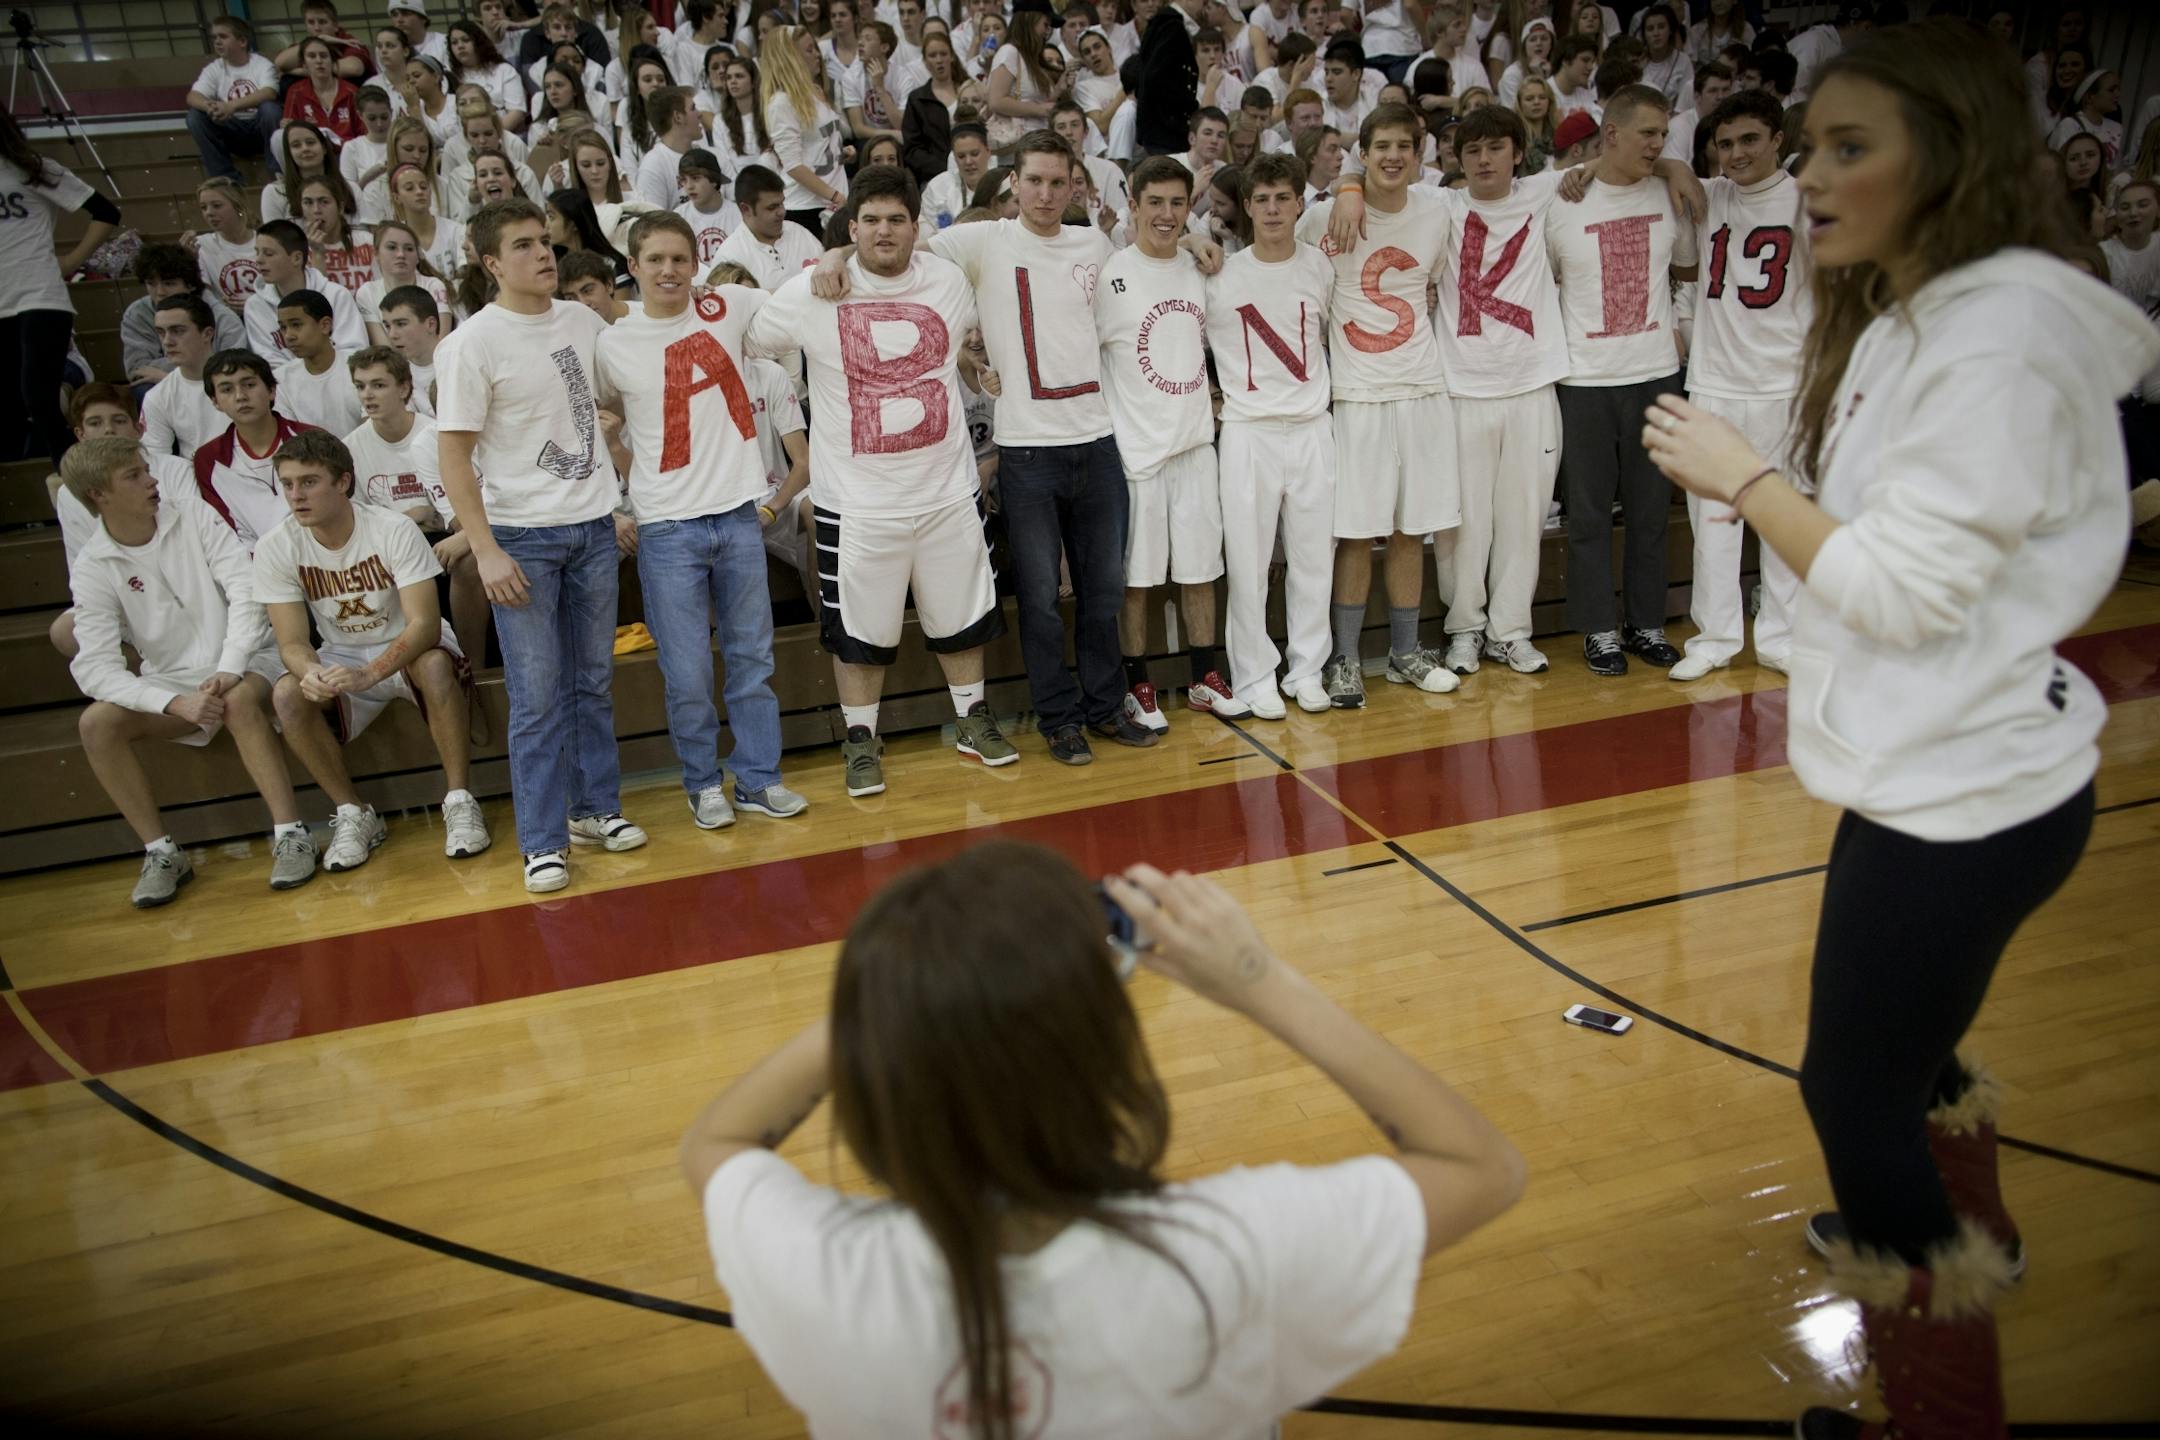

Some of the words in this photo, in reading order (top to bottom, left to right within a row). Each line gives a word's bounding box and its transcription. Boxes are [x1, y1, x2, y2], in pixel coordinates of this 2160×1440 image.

[1111, 278, 1127, 294] 13
[1153, 299, 1186, 316] TIMES
[1343, 246, 1419, 354] S
[1457, 210, 1535, 339] K
[1707, 222, 1793, 309] 13
[837, 301, 950, 455] B
[1016, 267, 1100, 400] L
[1235, 301, 1310, 392] N
[537, 345, 596, 480] J
[659, 329, 758, 474] A
[298, 553, 396, 602] MINNESOTA
